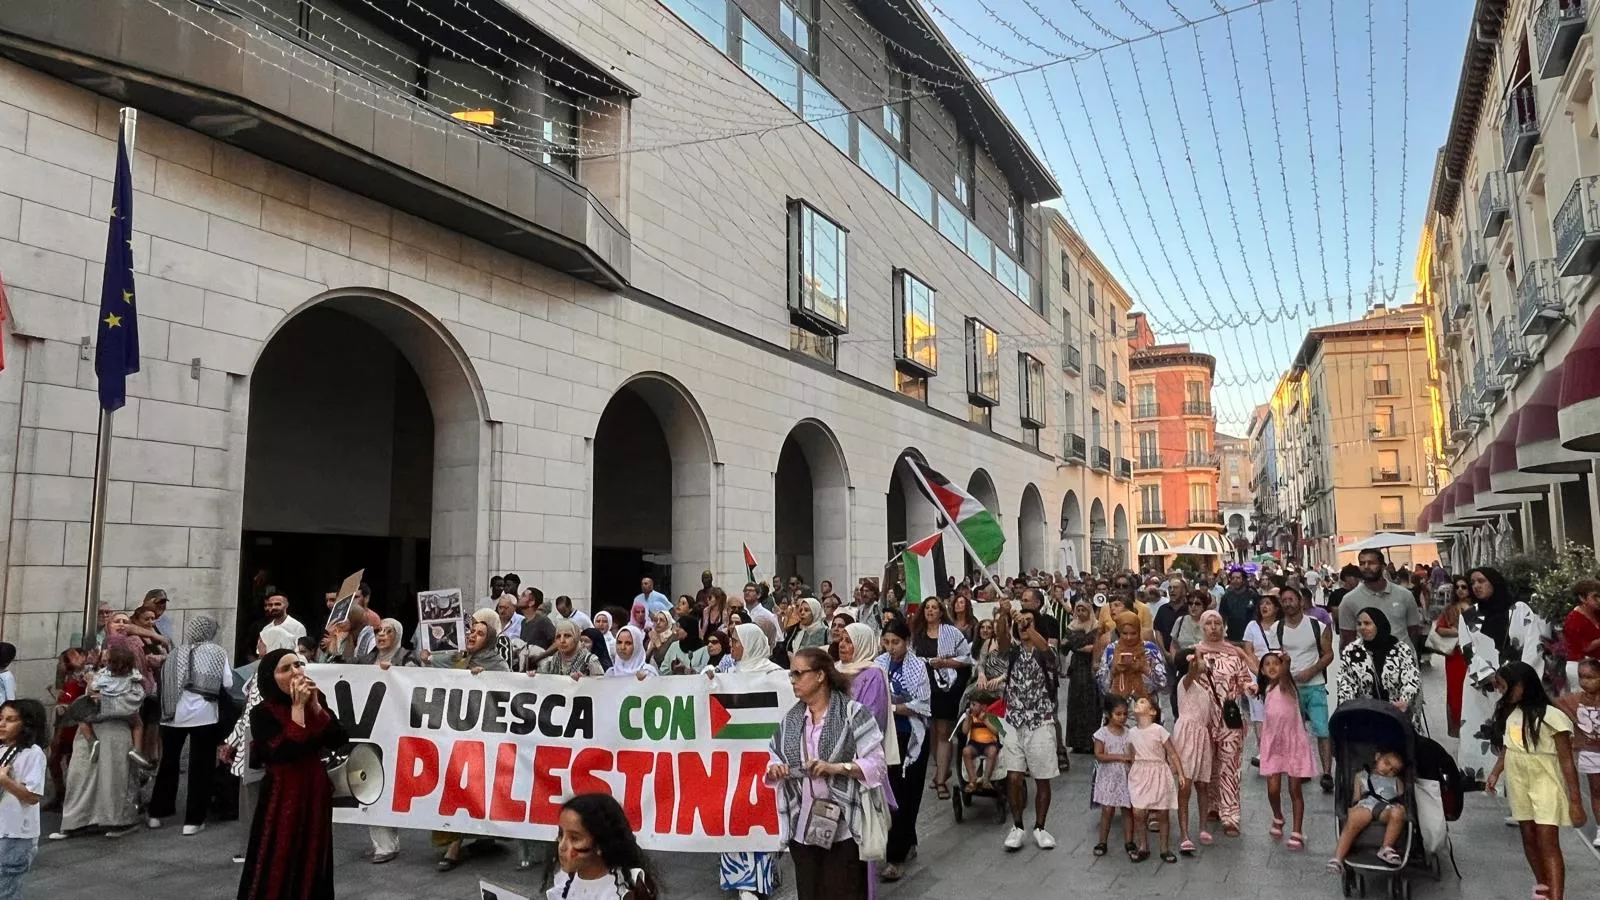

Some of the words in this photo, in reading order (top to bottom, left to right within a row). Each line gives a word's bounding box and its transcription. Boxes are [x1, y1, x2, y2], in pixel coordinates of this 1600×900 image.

[410, 687, 594, 739] HUESCA
[619, 695, 696, 741] CON
[391, 736, 780, 837] PALESTINA
